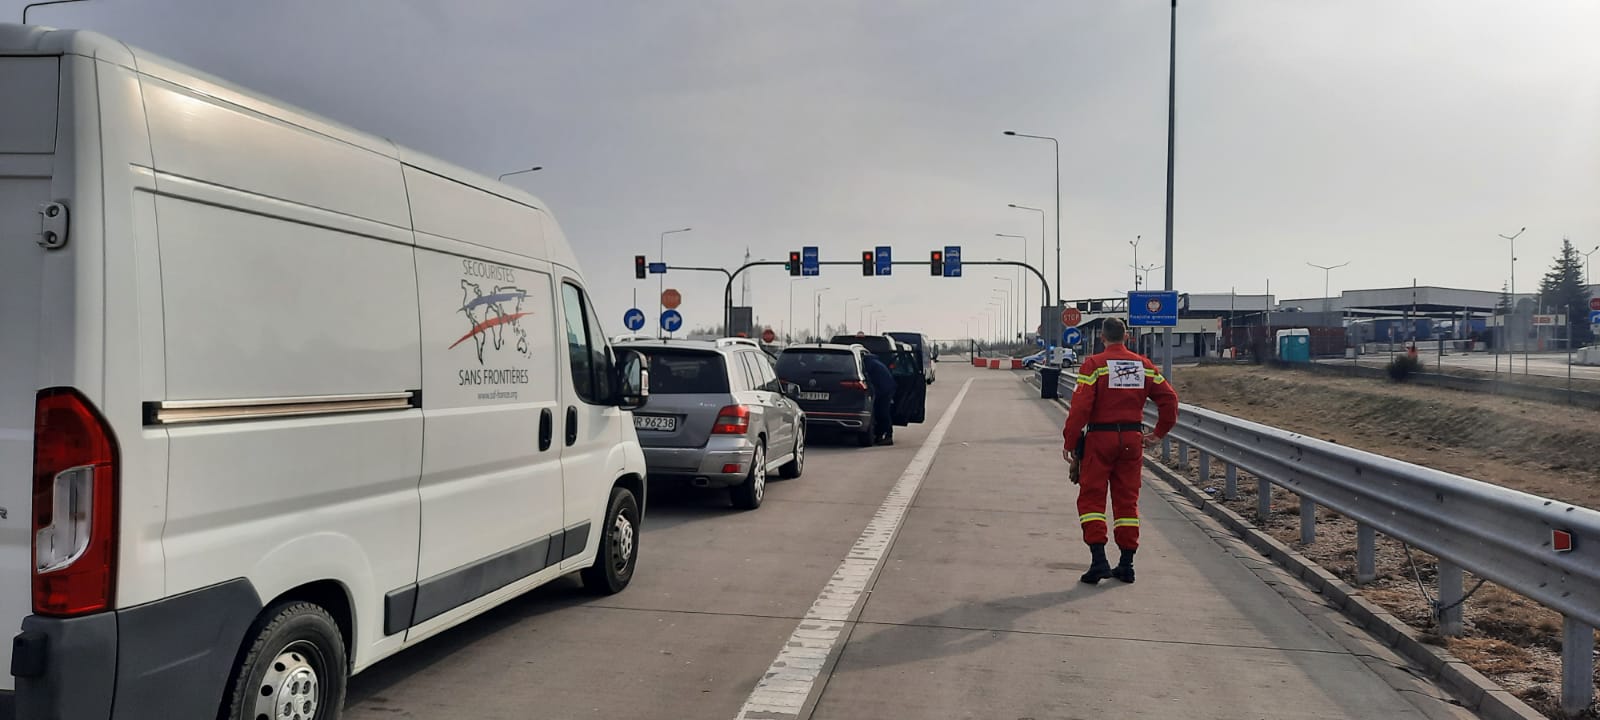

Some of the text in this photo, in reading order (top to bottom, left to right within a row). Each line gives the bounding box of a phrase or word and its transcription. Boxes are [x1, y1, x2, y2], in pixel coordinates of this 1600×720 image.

[463, 259, 515, 283] SECOURISTES
[1063, 313, 1080, 321] STOP
[458, 366, 529, 386] SANS FRONTIÈRES
[645, 417, 674, 428] 96238
